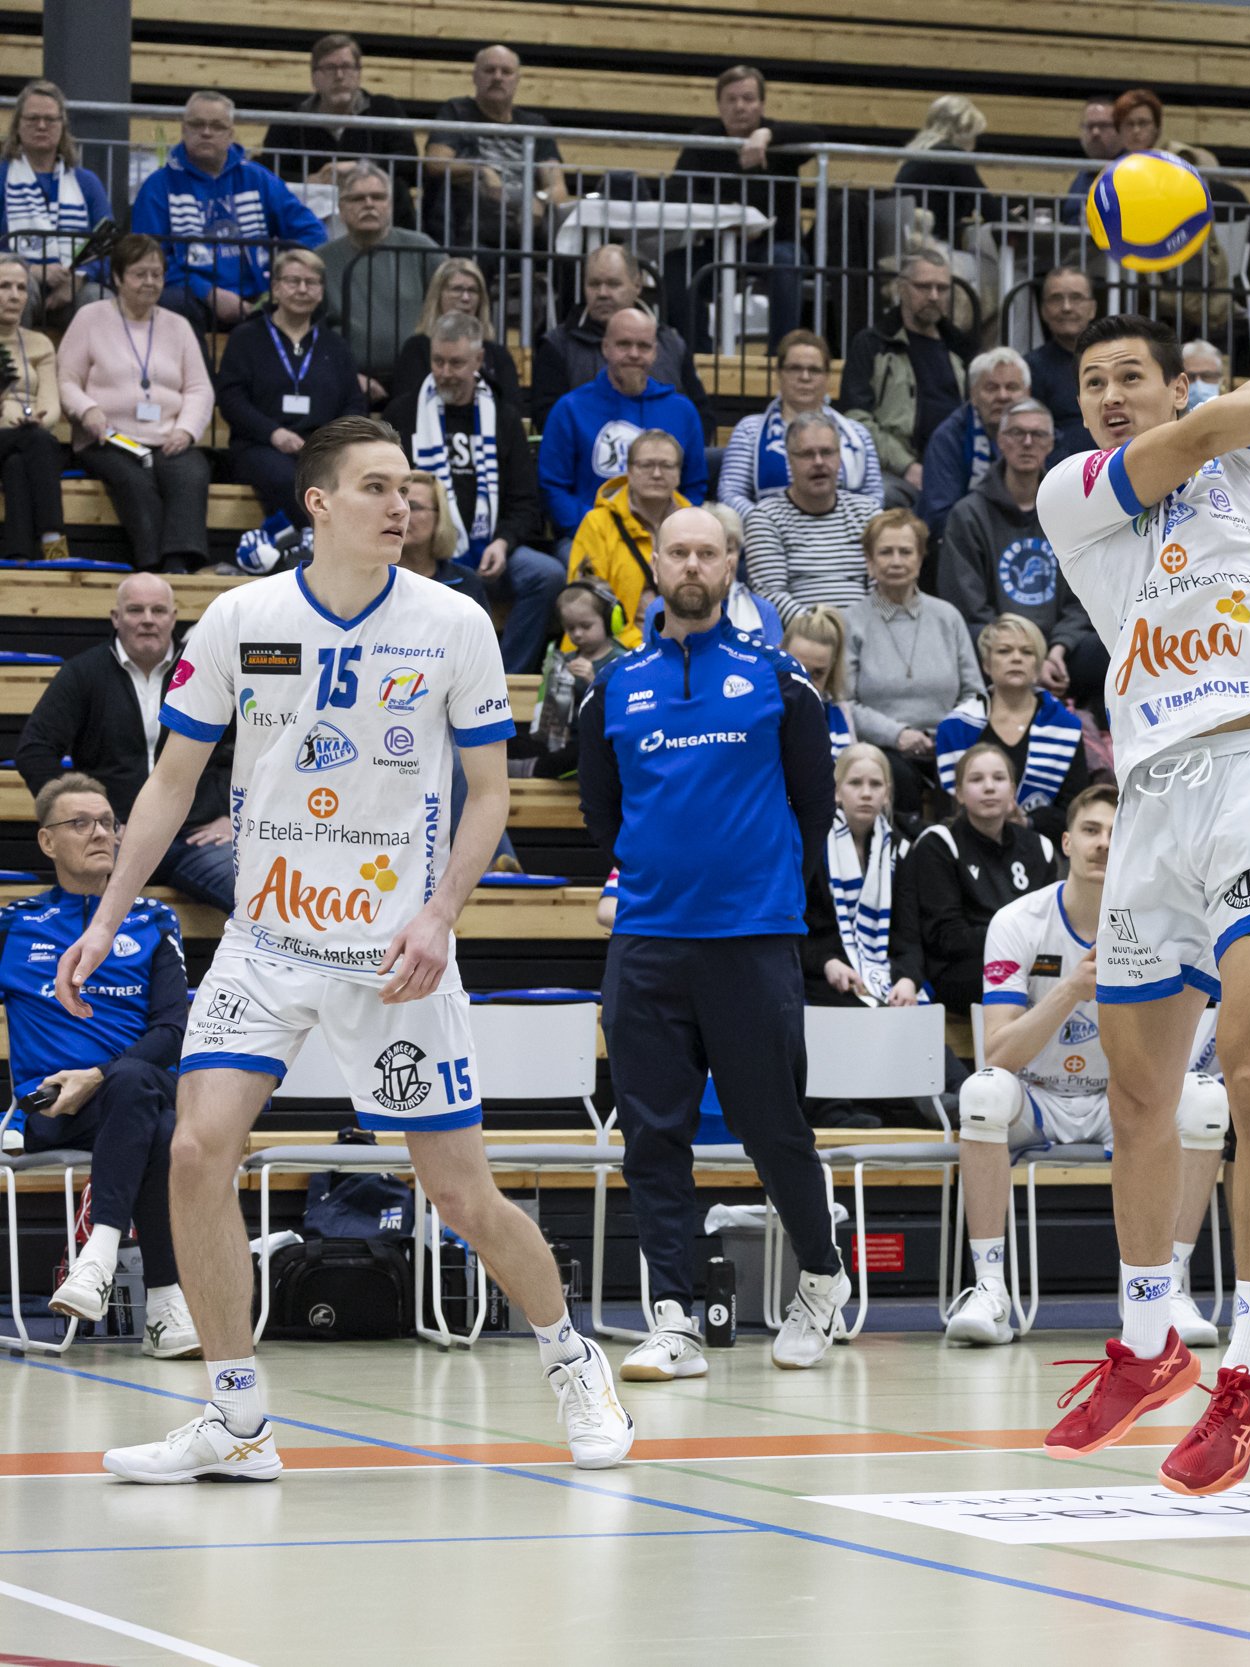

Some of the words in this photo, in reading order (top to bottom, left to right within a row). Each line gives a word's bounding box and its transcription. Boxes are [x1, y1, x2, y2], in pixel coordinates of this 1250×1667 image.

[371, 642, 446, 659] jakosport.fi
[1115, 617, 1243, 696] Akaa
[316, 644, 363, 711] 15
[477, 696, 510, 715] ePar
[628, 689, 654, 703] JAKO
[665, 731, 748, 750] MEGATREX
[259, 821, 411, 847] Etelä-Pirkanmaa
[1011, 861, 1030, 891] 8
[247, 856, 382, 932] Akaa
[1107, 957, 1130, 966] GLASS
[204, 1036, 224, 1046] 1793
[380, 1043, 418, 1065] HÄMEEN
[437, 1057, 473, 1105] 15
[374, 1084, 430, 1111] TURISTIAUTO
[379, 1219, 402, 1231] FIN
[713, 1308, 722, 1322] 3
